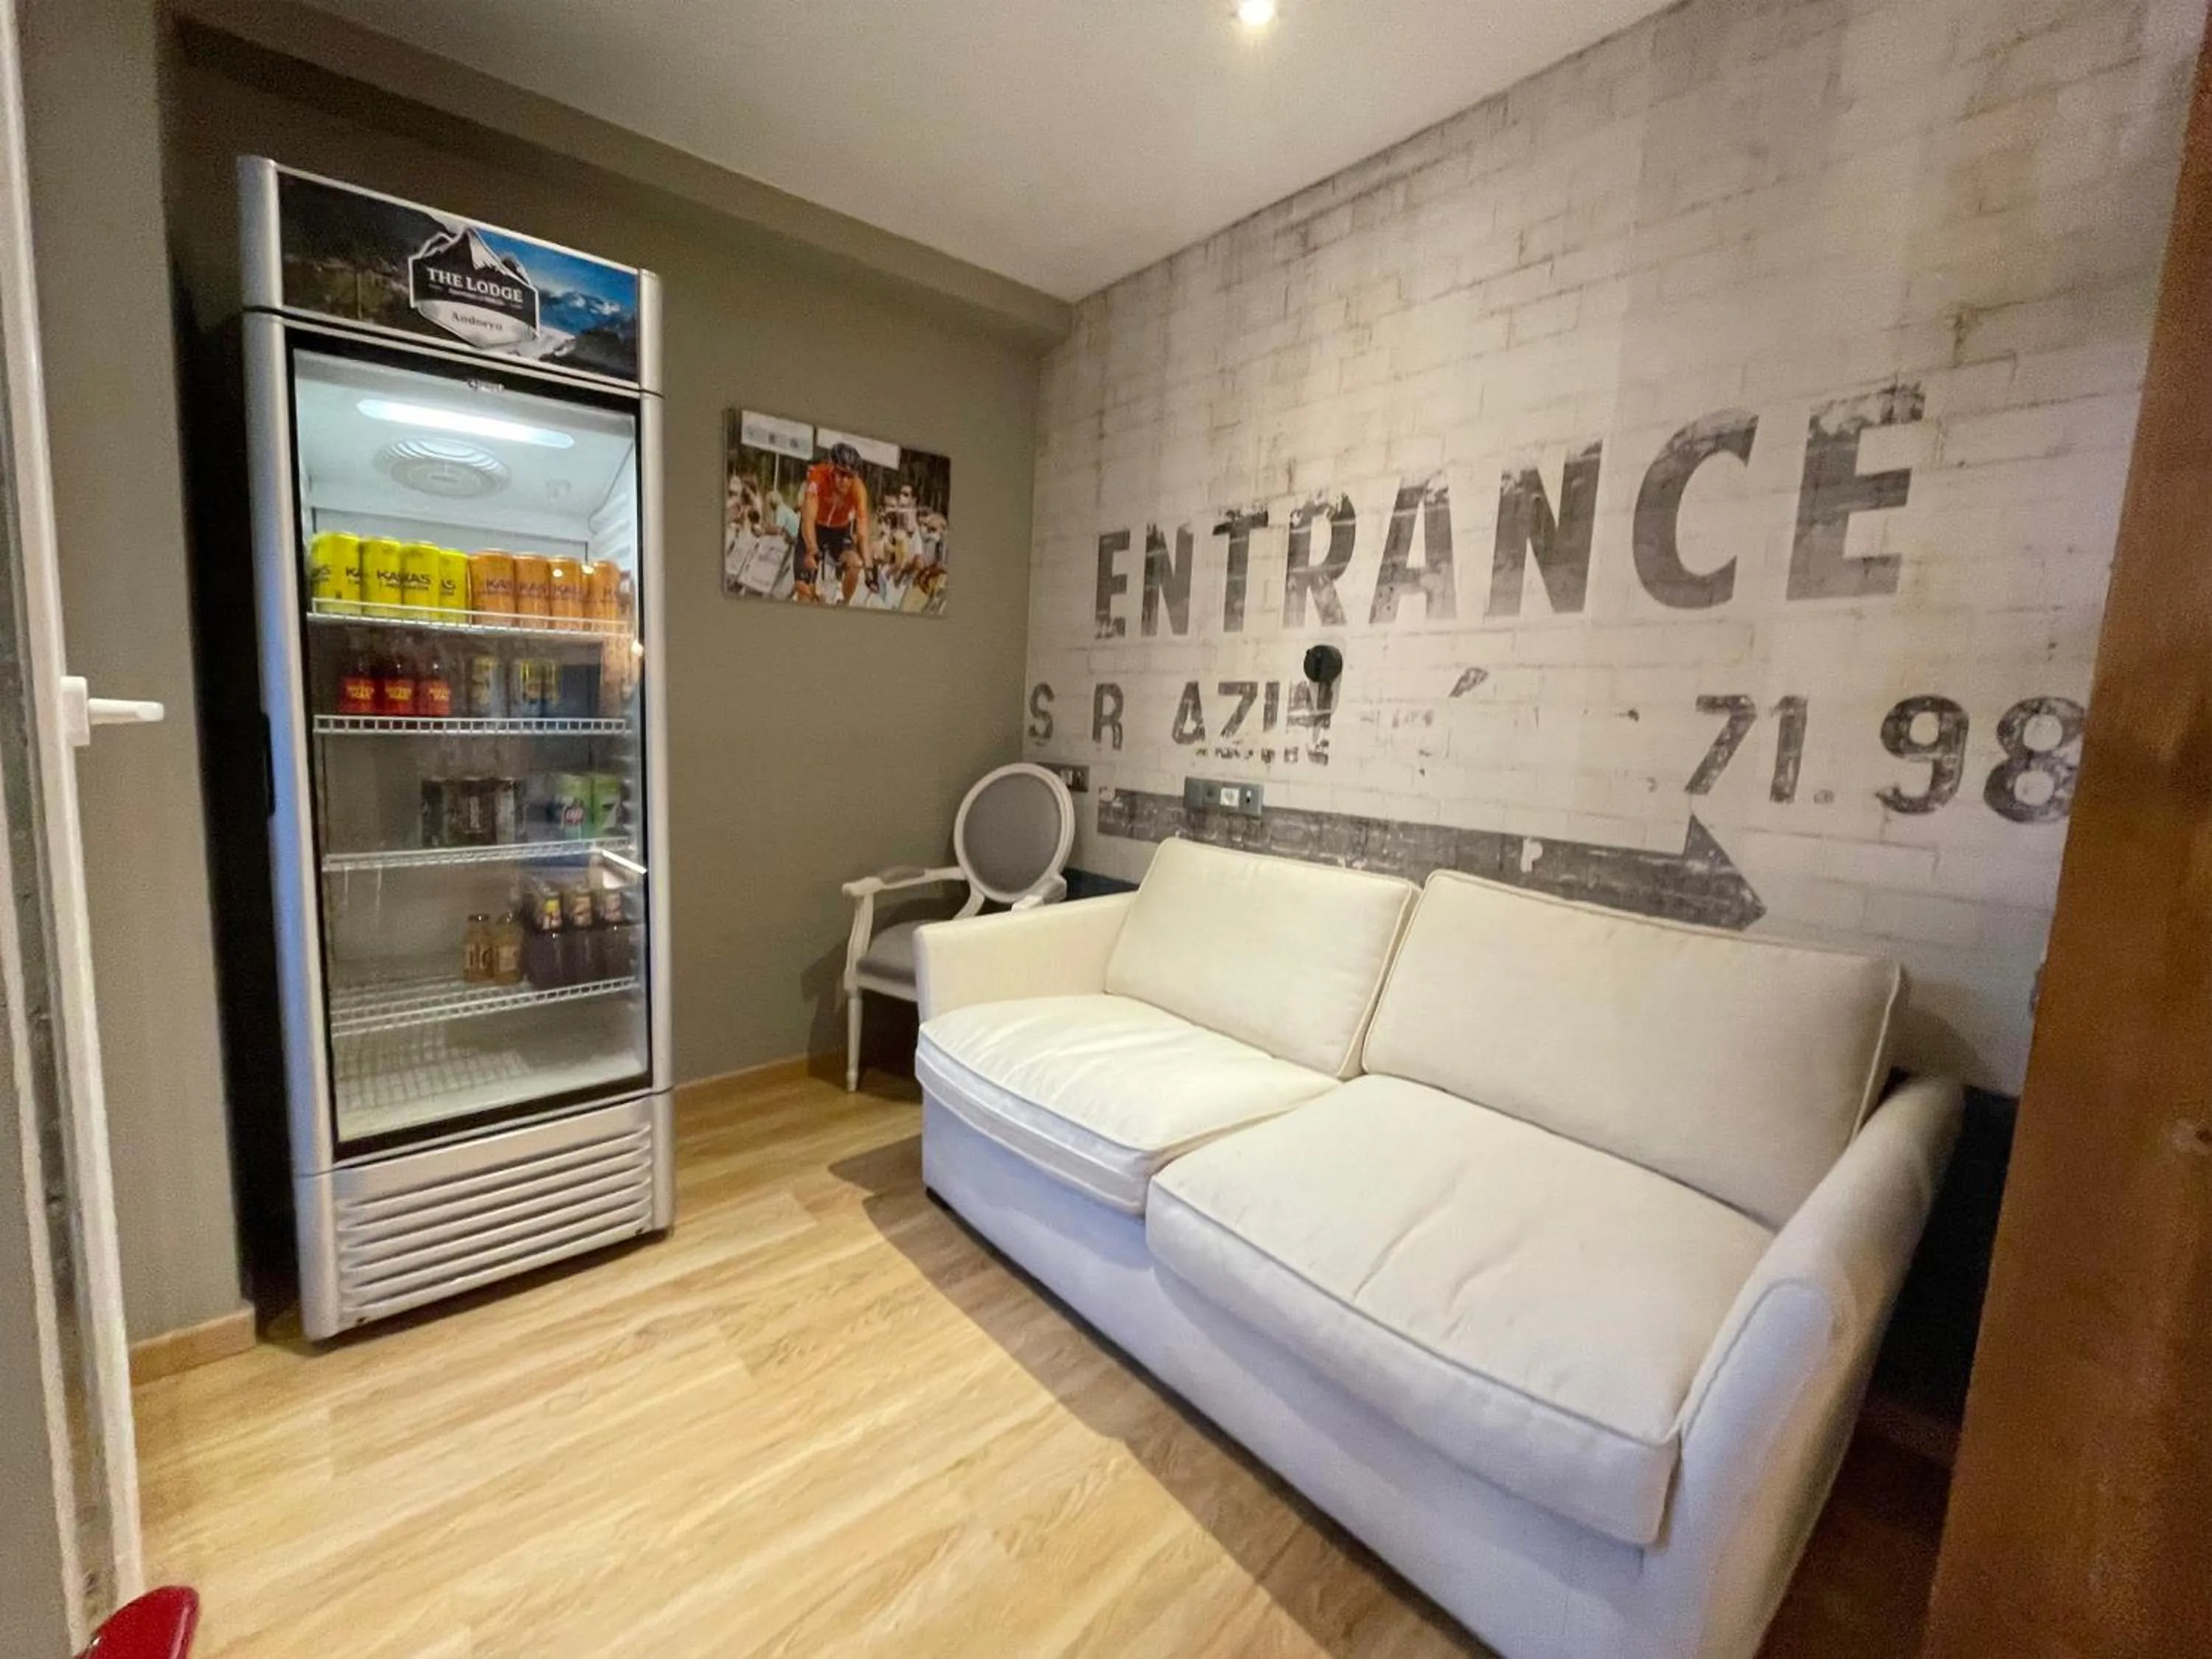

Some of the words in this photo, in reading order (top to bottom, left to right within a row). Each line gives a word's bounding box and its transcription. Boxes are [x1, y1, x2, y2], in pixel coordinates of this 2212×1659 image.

[427, 267, 463, 288] THE
[465, 276, 523, 303] LODGE
[1095, 380, 1926, 639] ENTRANCE
[1092, 683, 1124, 751] R
